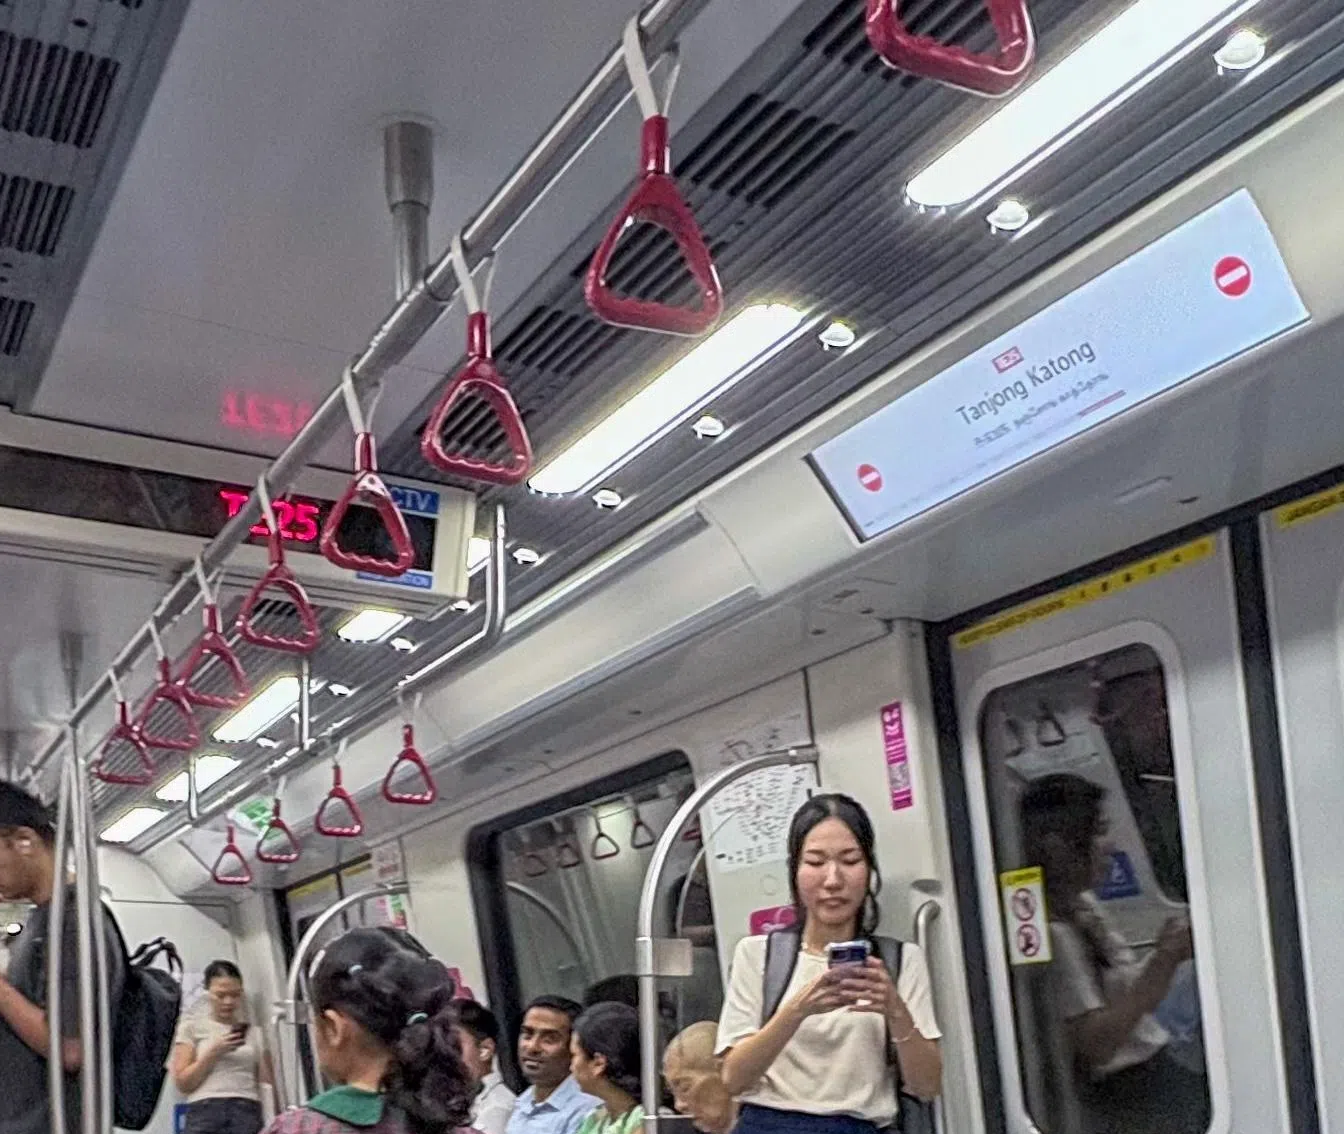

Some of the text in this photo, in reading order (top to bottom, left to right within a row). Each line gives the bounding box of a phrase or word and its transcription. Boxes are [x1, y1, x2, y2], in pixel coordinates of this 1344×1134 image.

[955, 378, 1029, 425] Tanjong
[1026, 342, 1096, 387] Katong
[219, 489, 320, 543] T25
[393, 487, 433, 511] CTV
